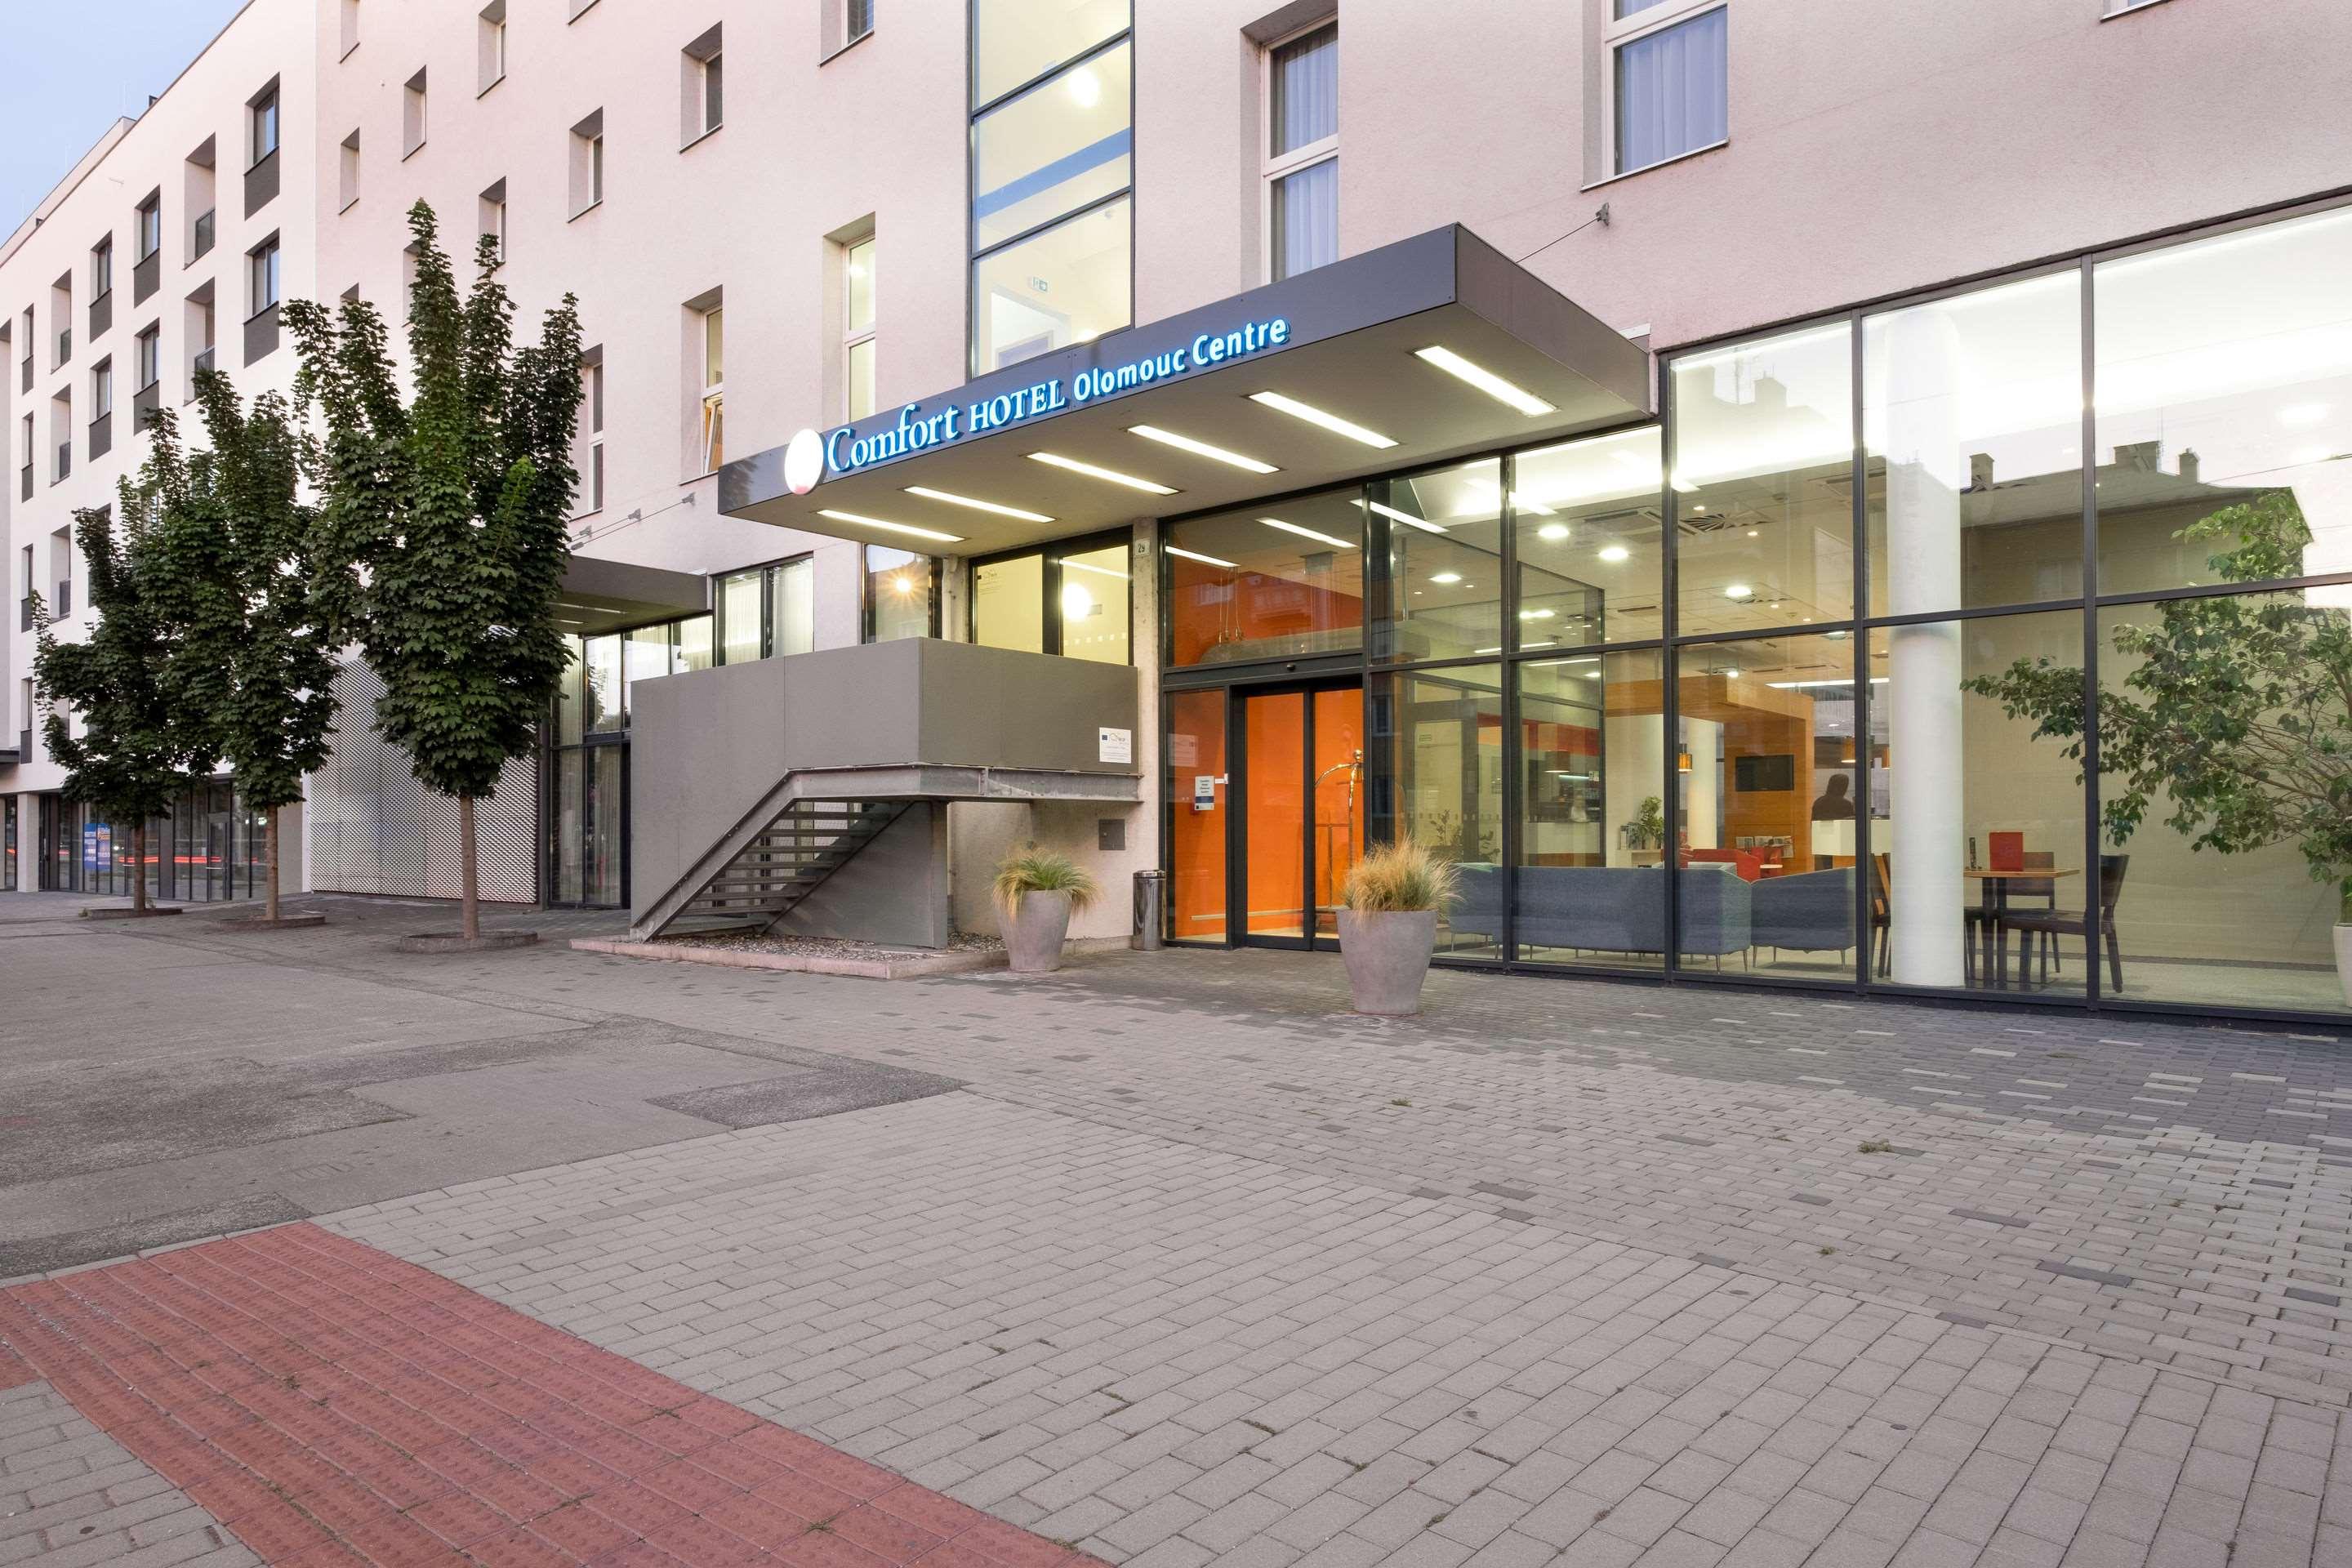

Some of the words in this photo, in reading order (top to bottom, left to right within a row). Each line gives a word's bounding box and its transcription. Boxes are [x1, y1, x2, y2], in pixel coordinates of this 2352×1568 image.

[827, 403, 960, 472] Comfort
[969, 379, 1066, 432] HOTEL
[1073, 349, 1186, 402] Olomouc
[1192, 318, 1288, 366] Centre
